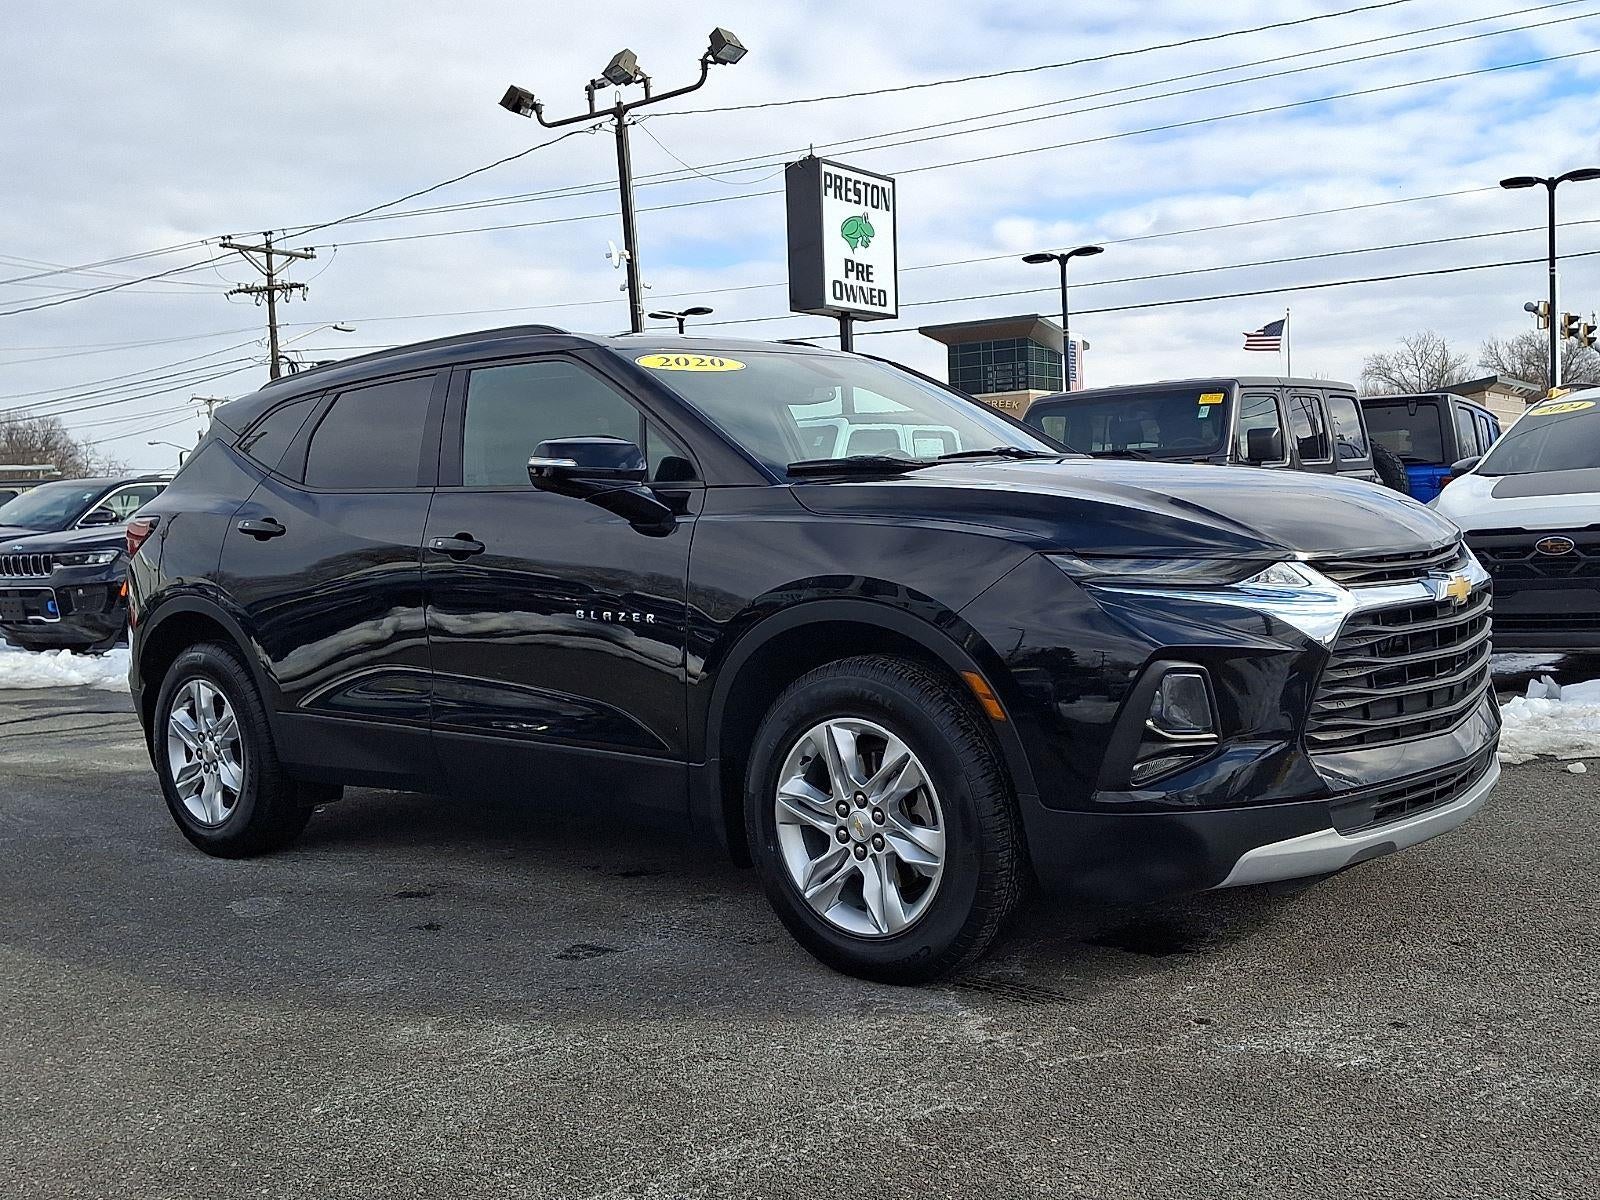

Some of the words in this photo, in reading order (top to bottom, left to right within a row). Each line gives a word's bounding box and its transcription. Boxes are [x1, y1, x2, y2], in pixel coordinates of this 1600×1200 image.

[824, 170, 890, 212] PRESTON
[844, 258, 874, 283] PRE
[832, 279, 887, 307] OWNED
[657, 356, 725, 367] 2020
[576, 609, 655, 624] BLAZER
